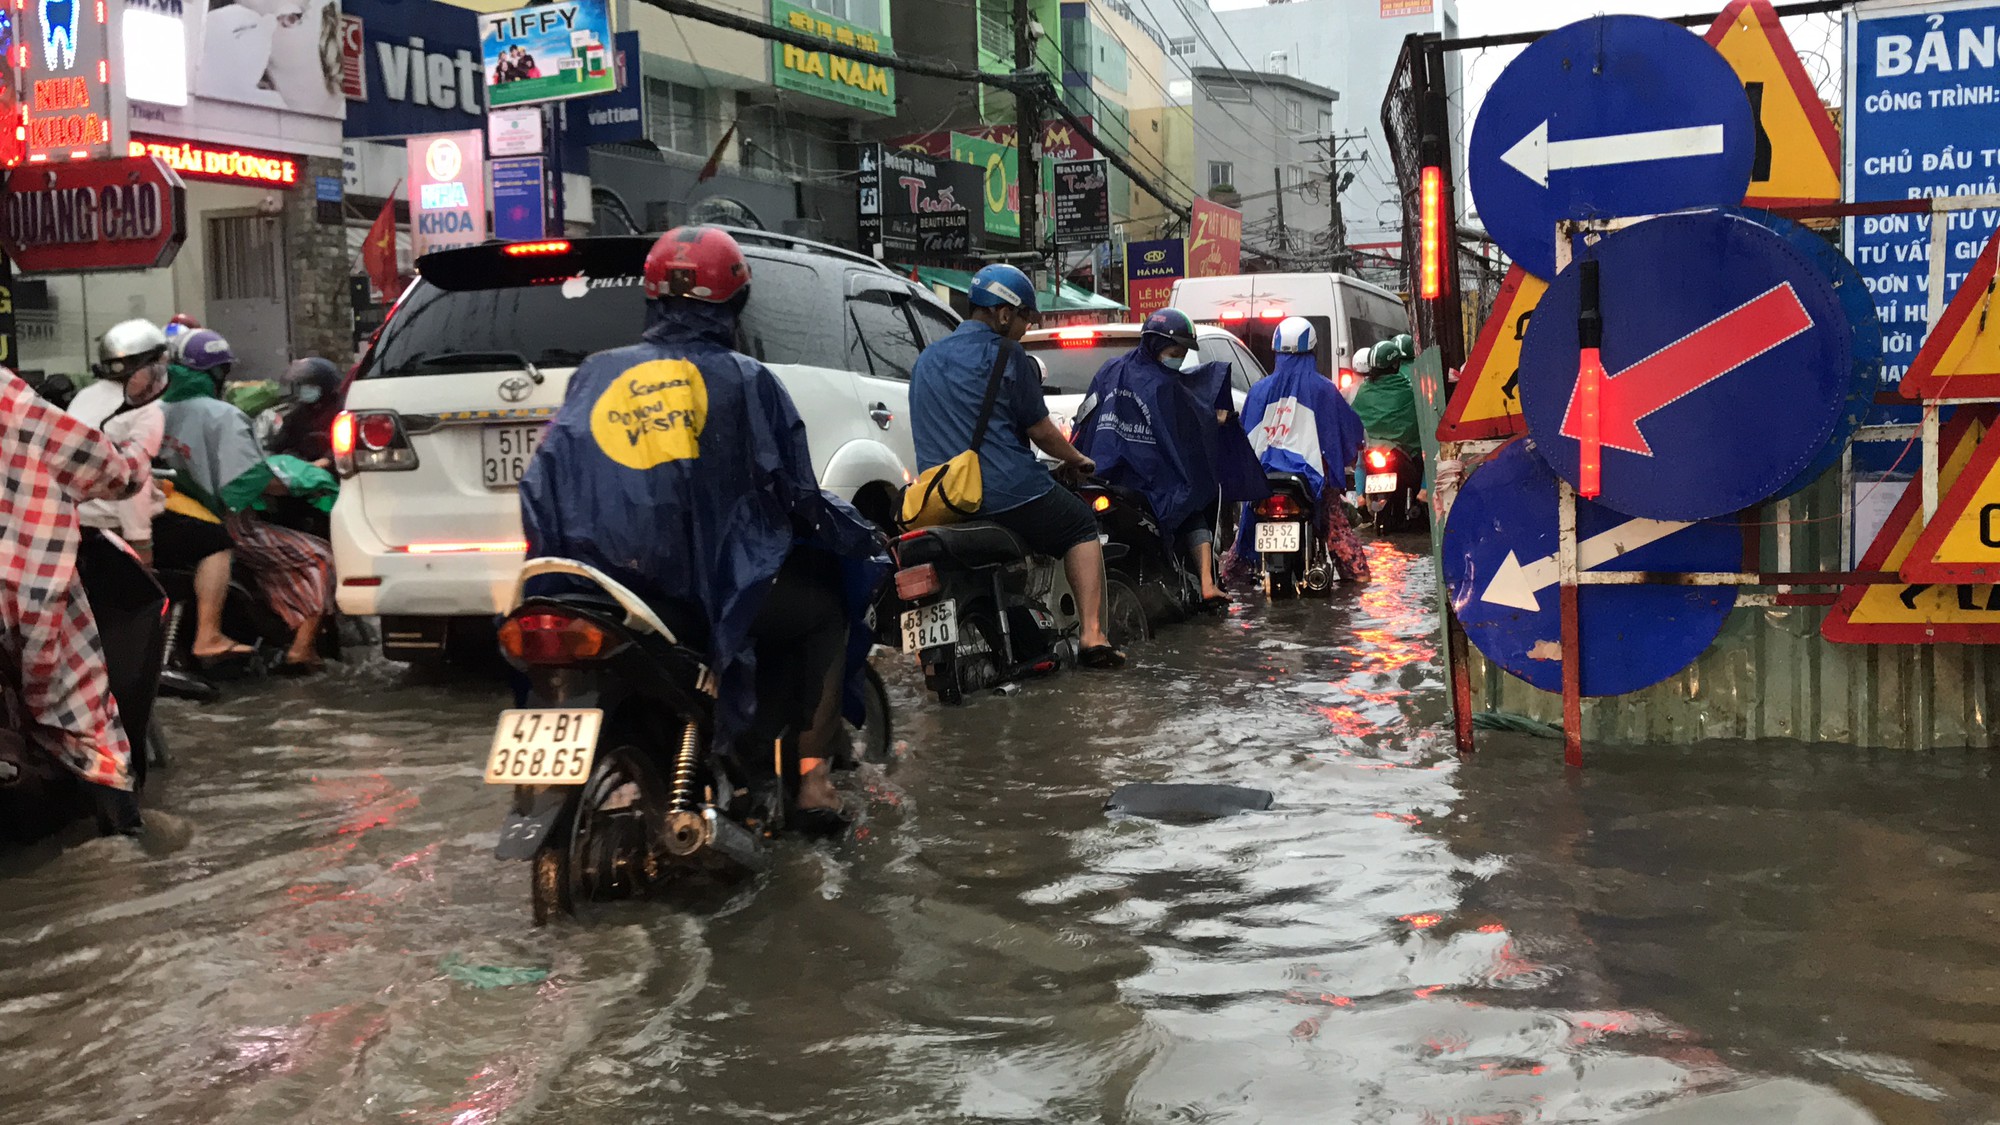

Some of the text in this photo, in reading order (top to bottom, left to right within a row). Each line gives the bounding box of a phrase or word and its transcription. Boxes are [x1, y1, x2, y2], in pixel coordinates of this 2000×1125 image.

[490, 6, 578, 41] TIFFY
[1876, 13, 2000, 77] BẢN
[829, 54, 888, 96] NAM
[34, 75, 90, 112] NHA
[1865, 83, 2000, 114] CÔNG TRÌNH:
[588, 107, 638, 126] viettien
[30, 113, 103, 149] KHOA
[1864, 144, 2000, 175] CHỦ ĐẦU T
[1955, 175, 2000, 198] QUẢ
[418, 210, 473, 235] KHOA
[920, 216, 944, 229] BEAUTY
[945, 215, 967, 228] SALON
[1864, 213, 1909, 235] ĐƠN
[1947, 208, 1977, 231] TƯ
[1982, 209, 2000, 229] V
[1858, 242, 1890, 264] TƯ
[591, 272, 636, 290] PHÁT
[1152, 267, 1174, 276] NAM
[1946, 271, 1970, 291] T
[500, 429, 538, 455] 51F
[1258, 537, 1297, 550] 851.45
[1262, 525, 1293, 537] 59-S2
[908, 623, 950, 650] 3840
[512, 713, 583, 743] 47-B1
[493, 747, 588, 777] 368.65
